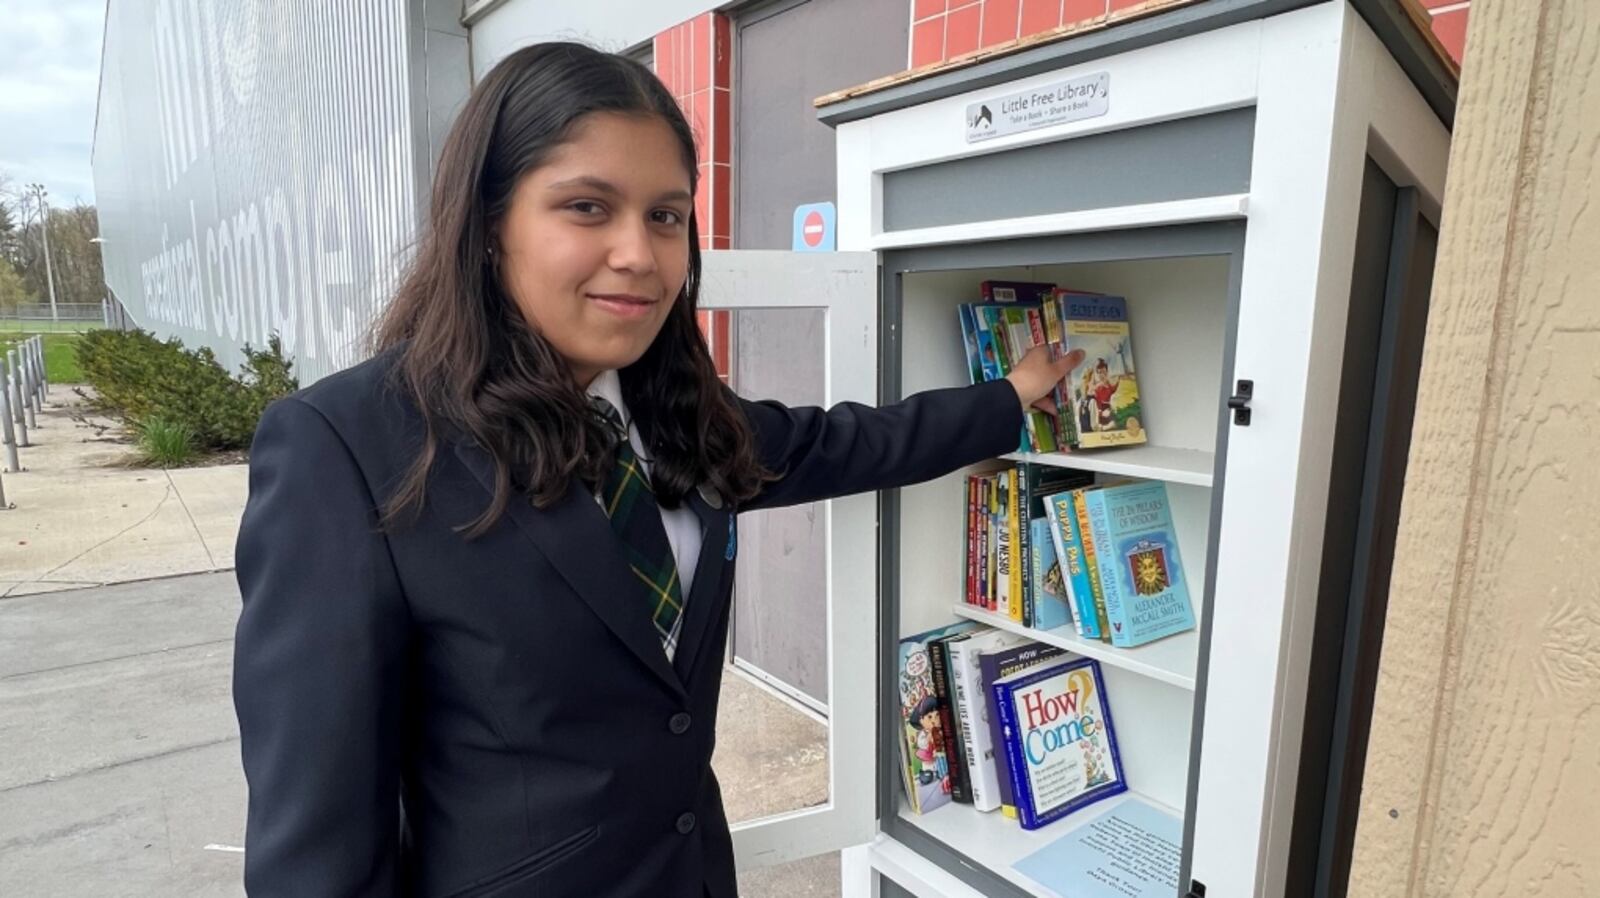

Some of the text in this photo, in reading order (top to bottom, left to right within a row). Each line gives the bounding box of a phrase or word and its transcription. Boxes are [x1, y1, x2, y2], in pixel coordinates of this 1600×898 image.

[1001, 81, 1099, 115] Little Free Library
[1028, 111, 1042, 121] Book
[1049, 105, 1067, 116] Share
[1072, 100, 1088, 111] Book
[999, 528, 1010, 543] JO
[1134, 592, 1176, 612] ALEXANDER
[1161, 602, 1185, 618] SMITH
[1022, 689, 1080, 730] How
[1026, 715, 1095, 765] Come
